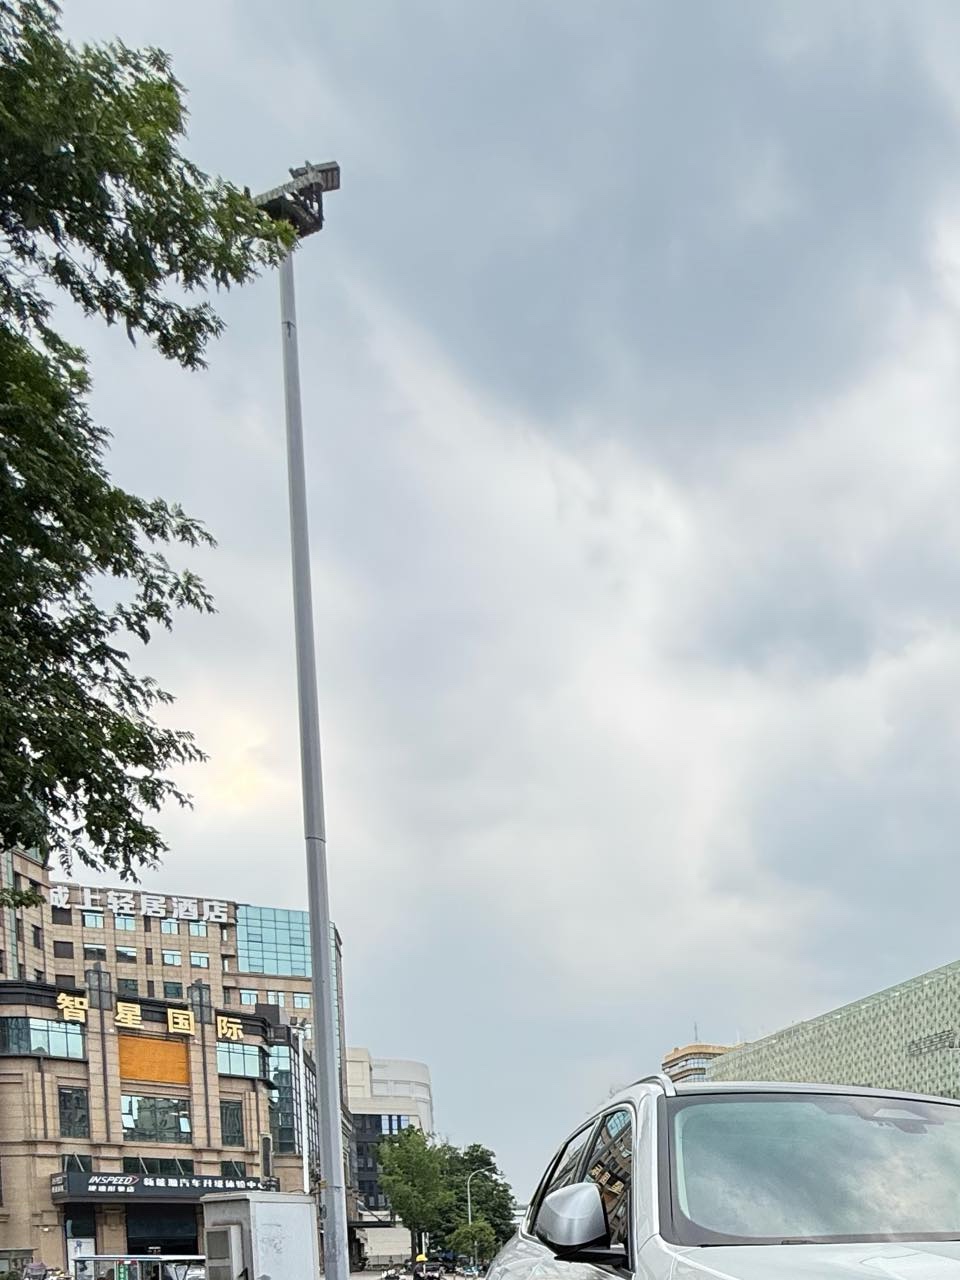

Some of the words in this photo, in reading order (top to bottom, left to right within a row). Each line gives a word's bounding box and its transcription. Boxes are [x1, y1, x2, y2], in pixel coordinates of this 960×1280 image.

[56, 992, 244, 1040] 智星国际
[88, 1175, 133, 1185] INSPEED
